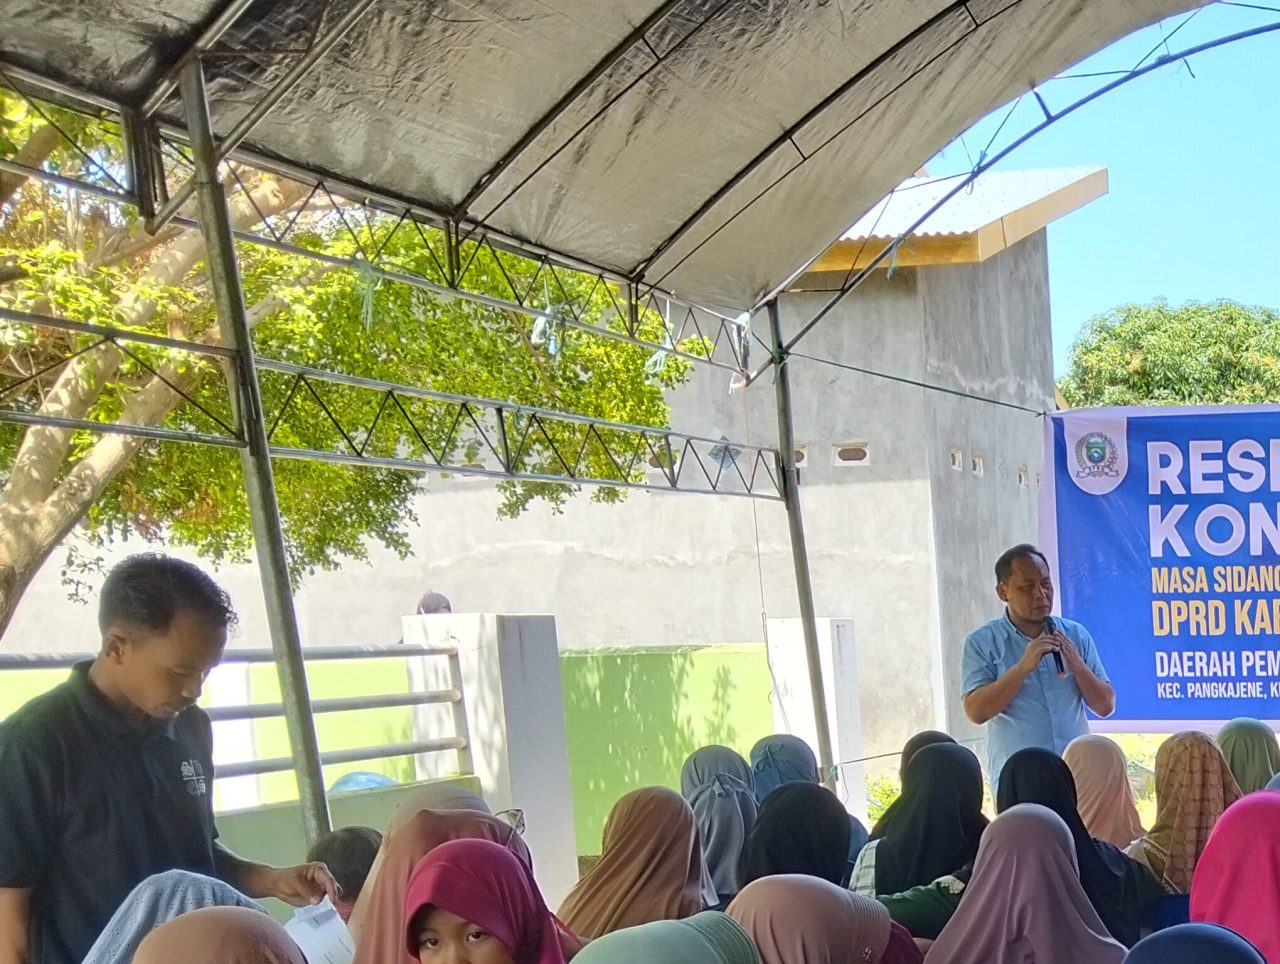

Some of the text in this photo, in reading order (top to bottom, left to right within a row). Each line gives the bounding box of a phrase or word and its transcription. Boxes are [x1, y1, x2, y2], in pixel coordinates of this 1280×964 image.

[1151, 566, 1209, 594] MASA
[1151, 599, 1226, 637] DPRD
[1155, 651, 1236, 678] DAERAH
[1157, 682, 1185, 699] KEC.
[1187, 681, 1268, 700] PANGKAJENE,
